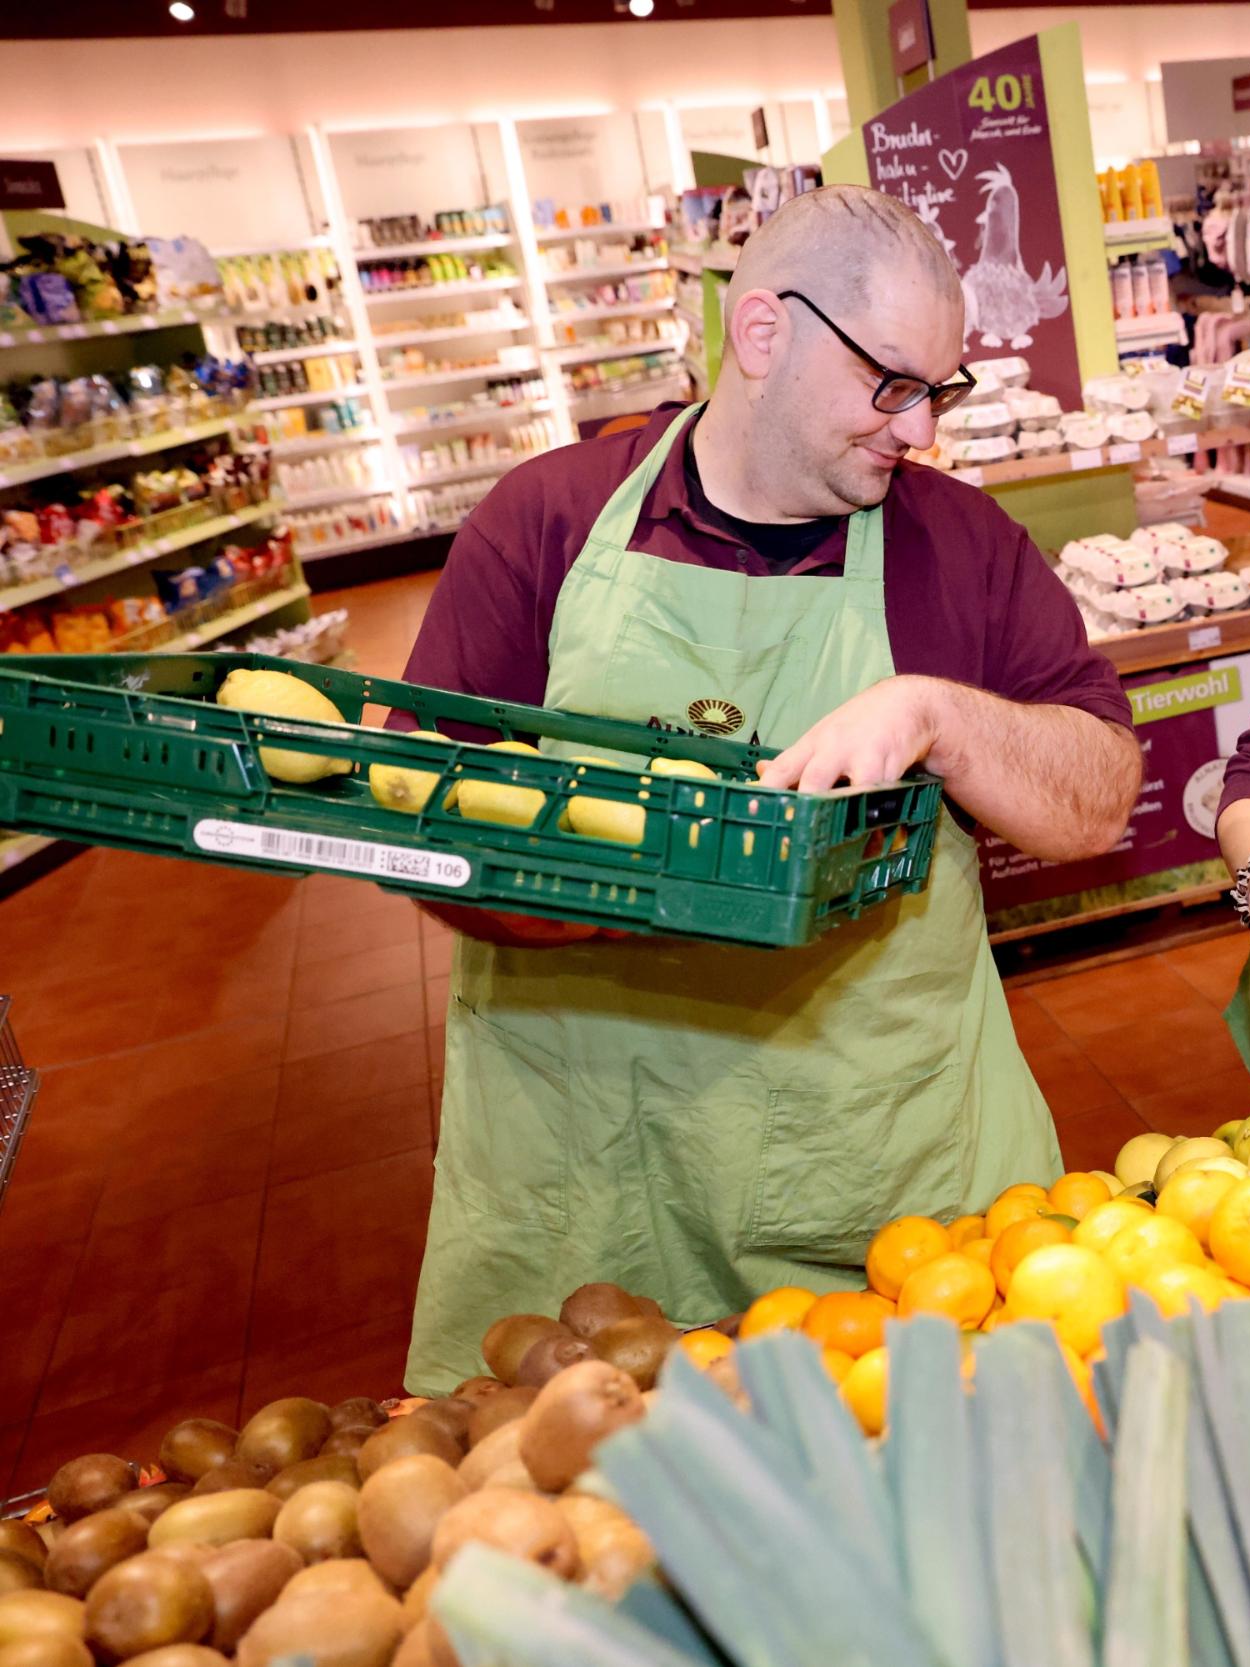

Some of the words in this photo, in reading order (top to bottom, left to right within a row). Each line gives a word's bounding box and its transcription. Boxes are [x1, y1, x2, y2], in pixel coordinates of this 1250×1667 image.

[968, 73, 1022, 112] 40
[1132, 673, 1230, 713] Tierwohl
[436, 861, 464, 880] 106
